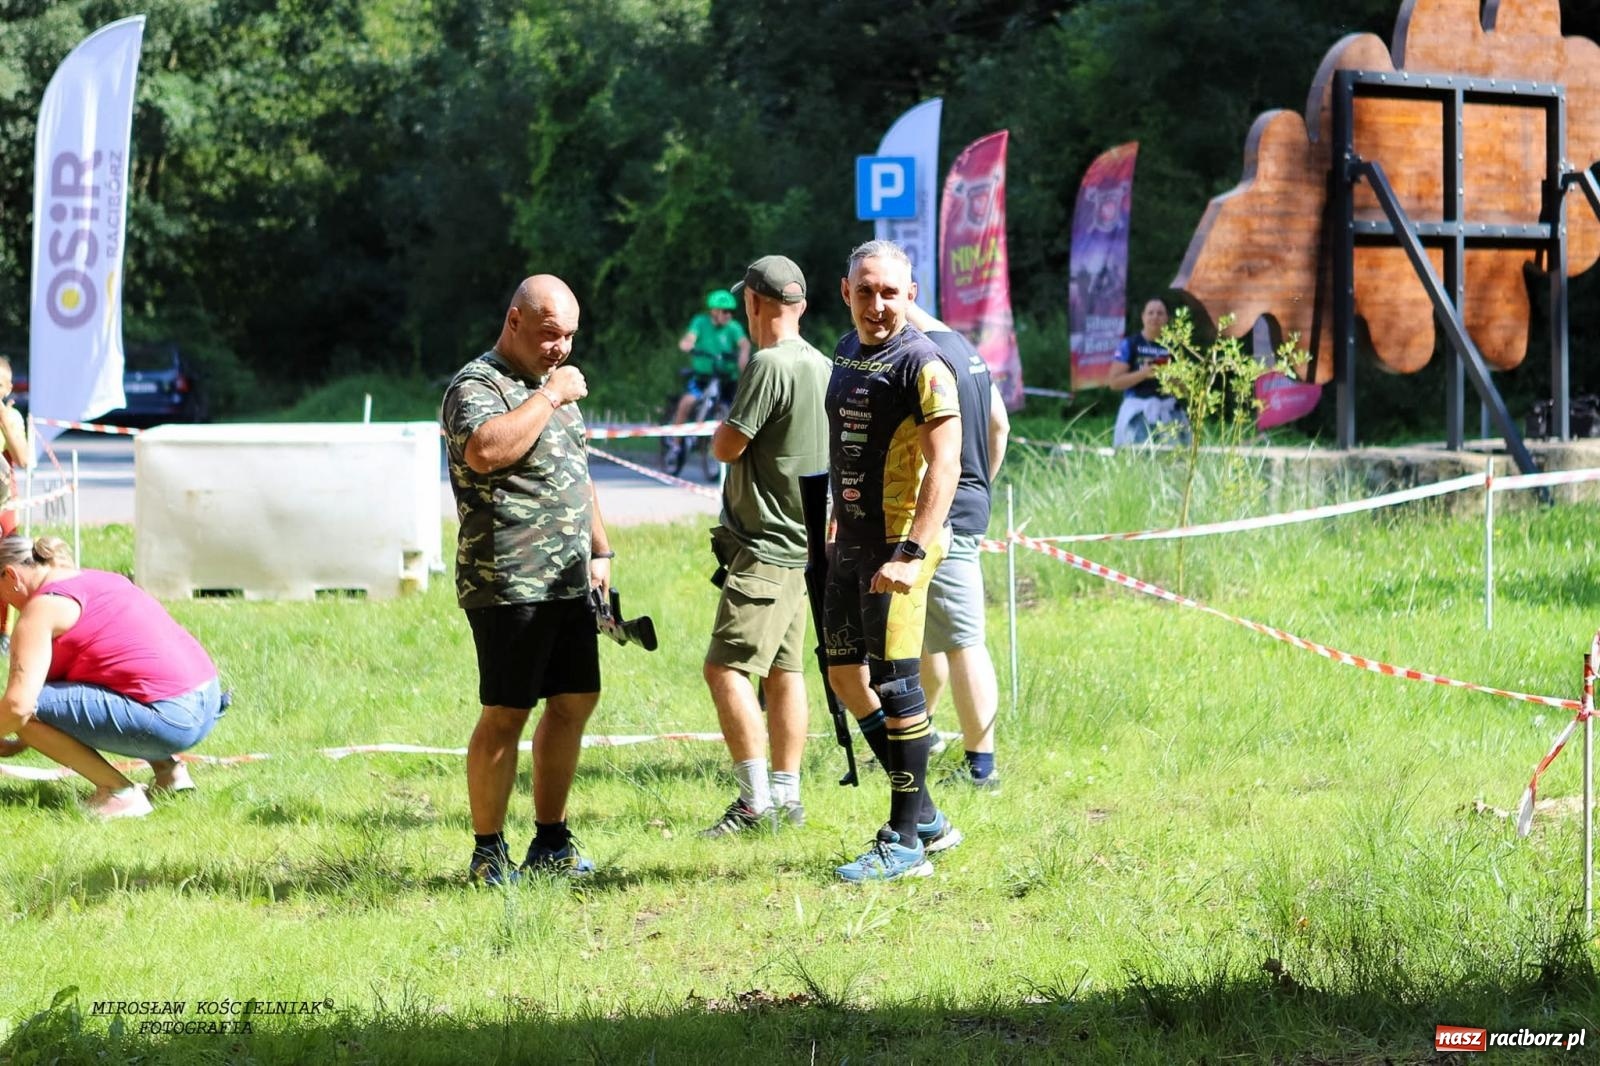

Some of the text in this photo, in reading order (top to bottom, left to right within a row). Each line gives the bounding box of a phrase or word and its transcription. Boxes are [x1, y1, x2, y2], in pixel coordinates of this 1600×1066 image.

[105, 150, 123, 259] RACIBÓRZ
[871, 162, 905, 212] P
[834, 356, 893, 373] CARBON
